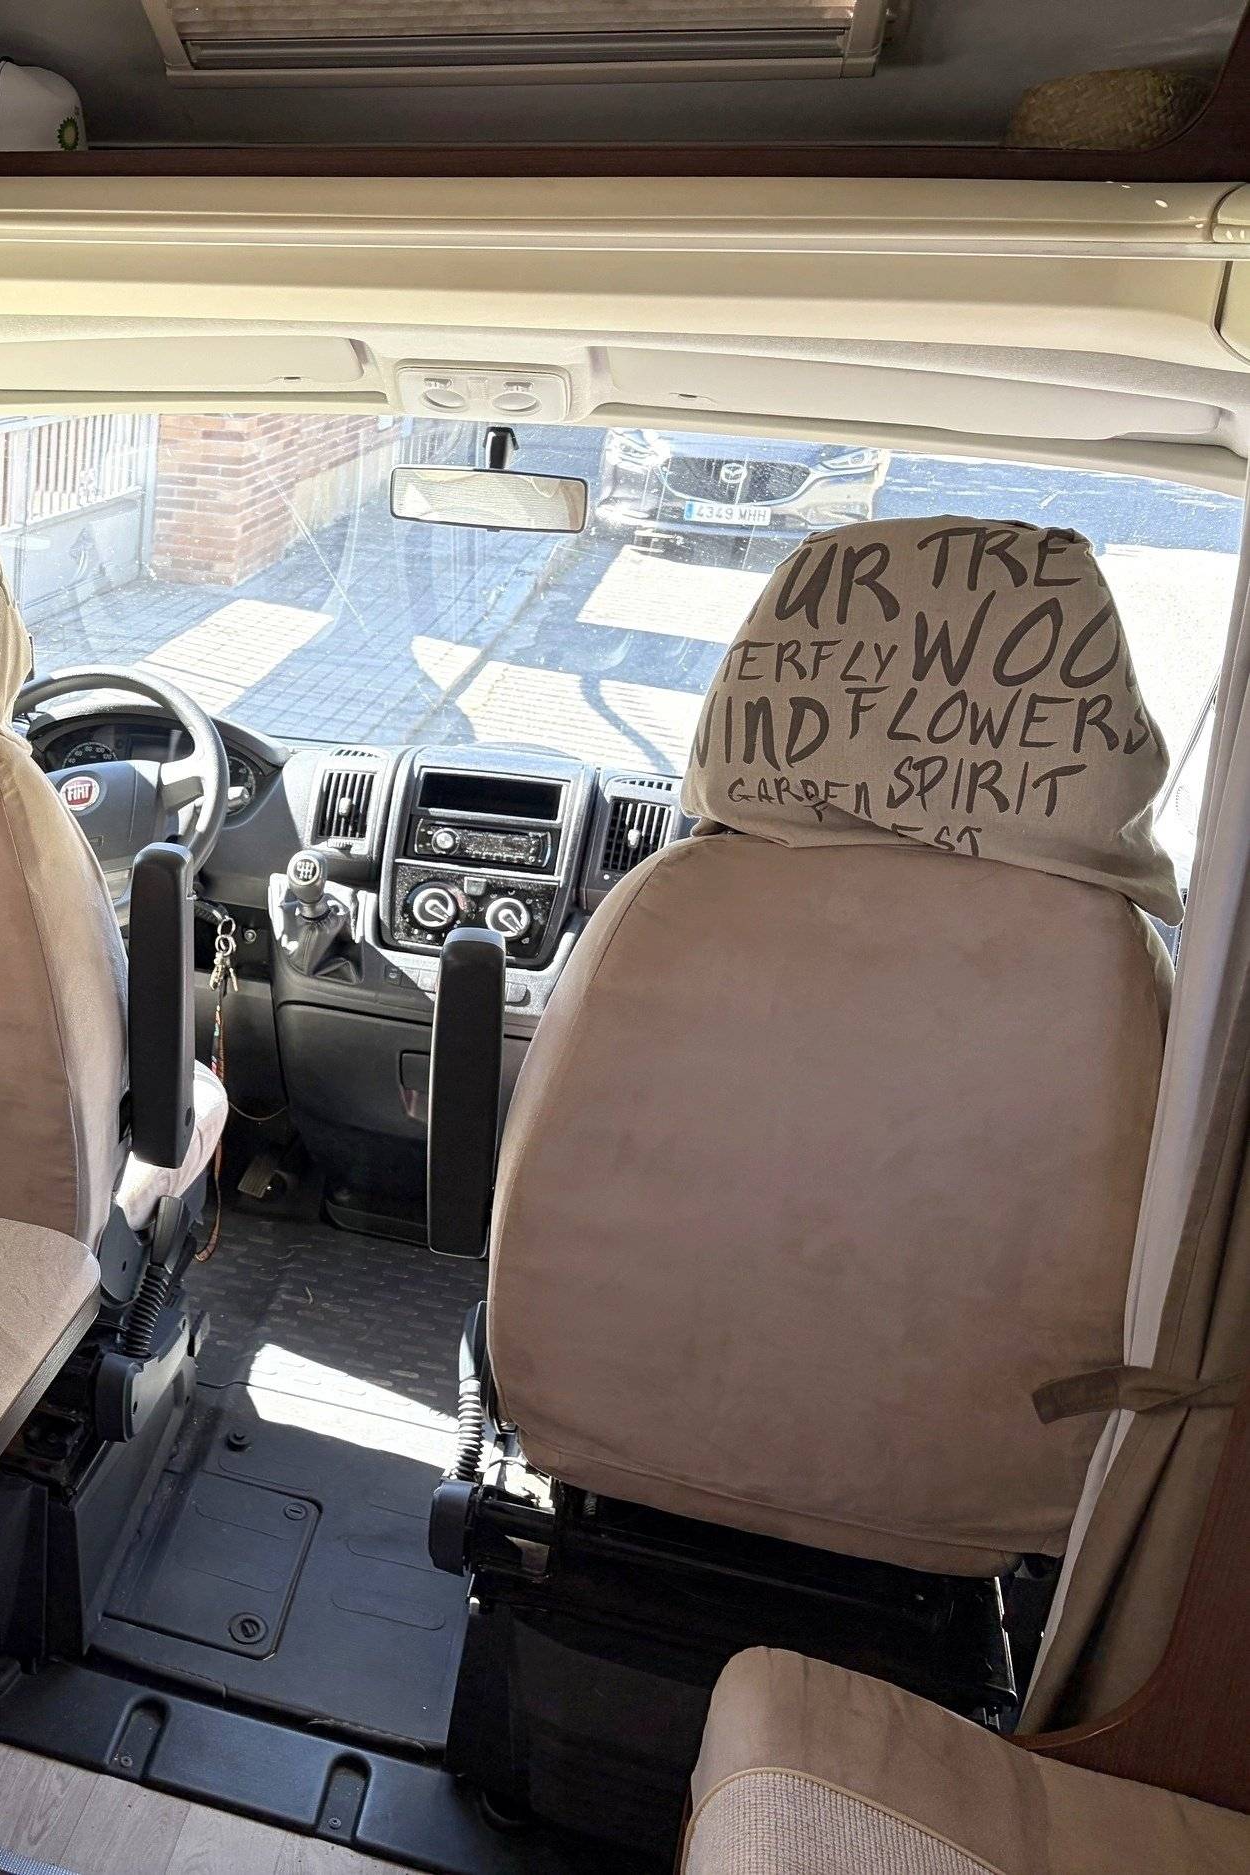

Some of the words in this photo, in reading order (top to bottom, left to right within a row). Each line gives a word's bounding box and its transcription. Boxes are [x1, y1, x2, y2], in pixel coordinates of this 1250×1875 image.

[756, 542, 901, 630] UR
[917, 527, 1095, 592] TRE
[913, 590, 1122, 688] WOO
[65, 783, 91, 802] FIAT
[886, 755, 1088, 818] SPIRIT
